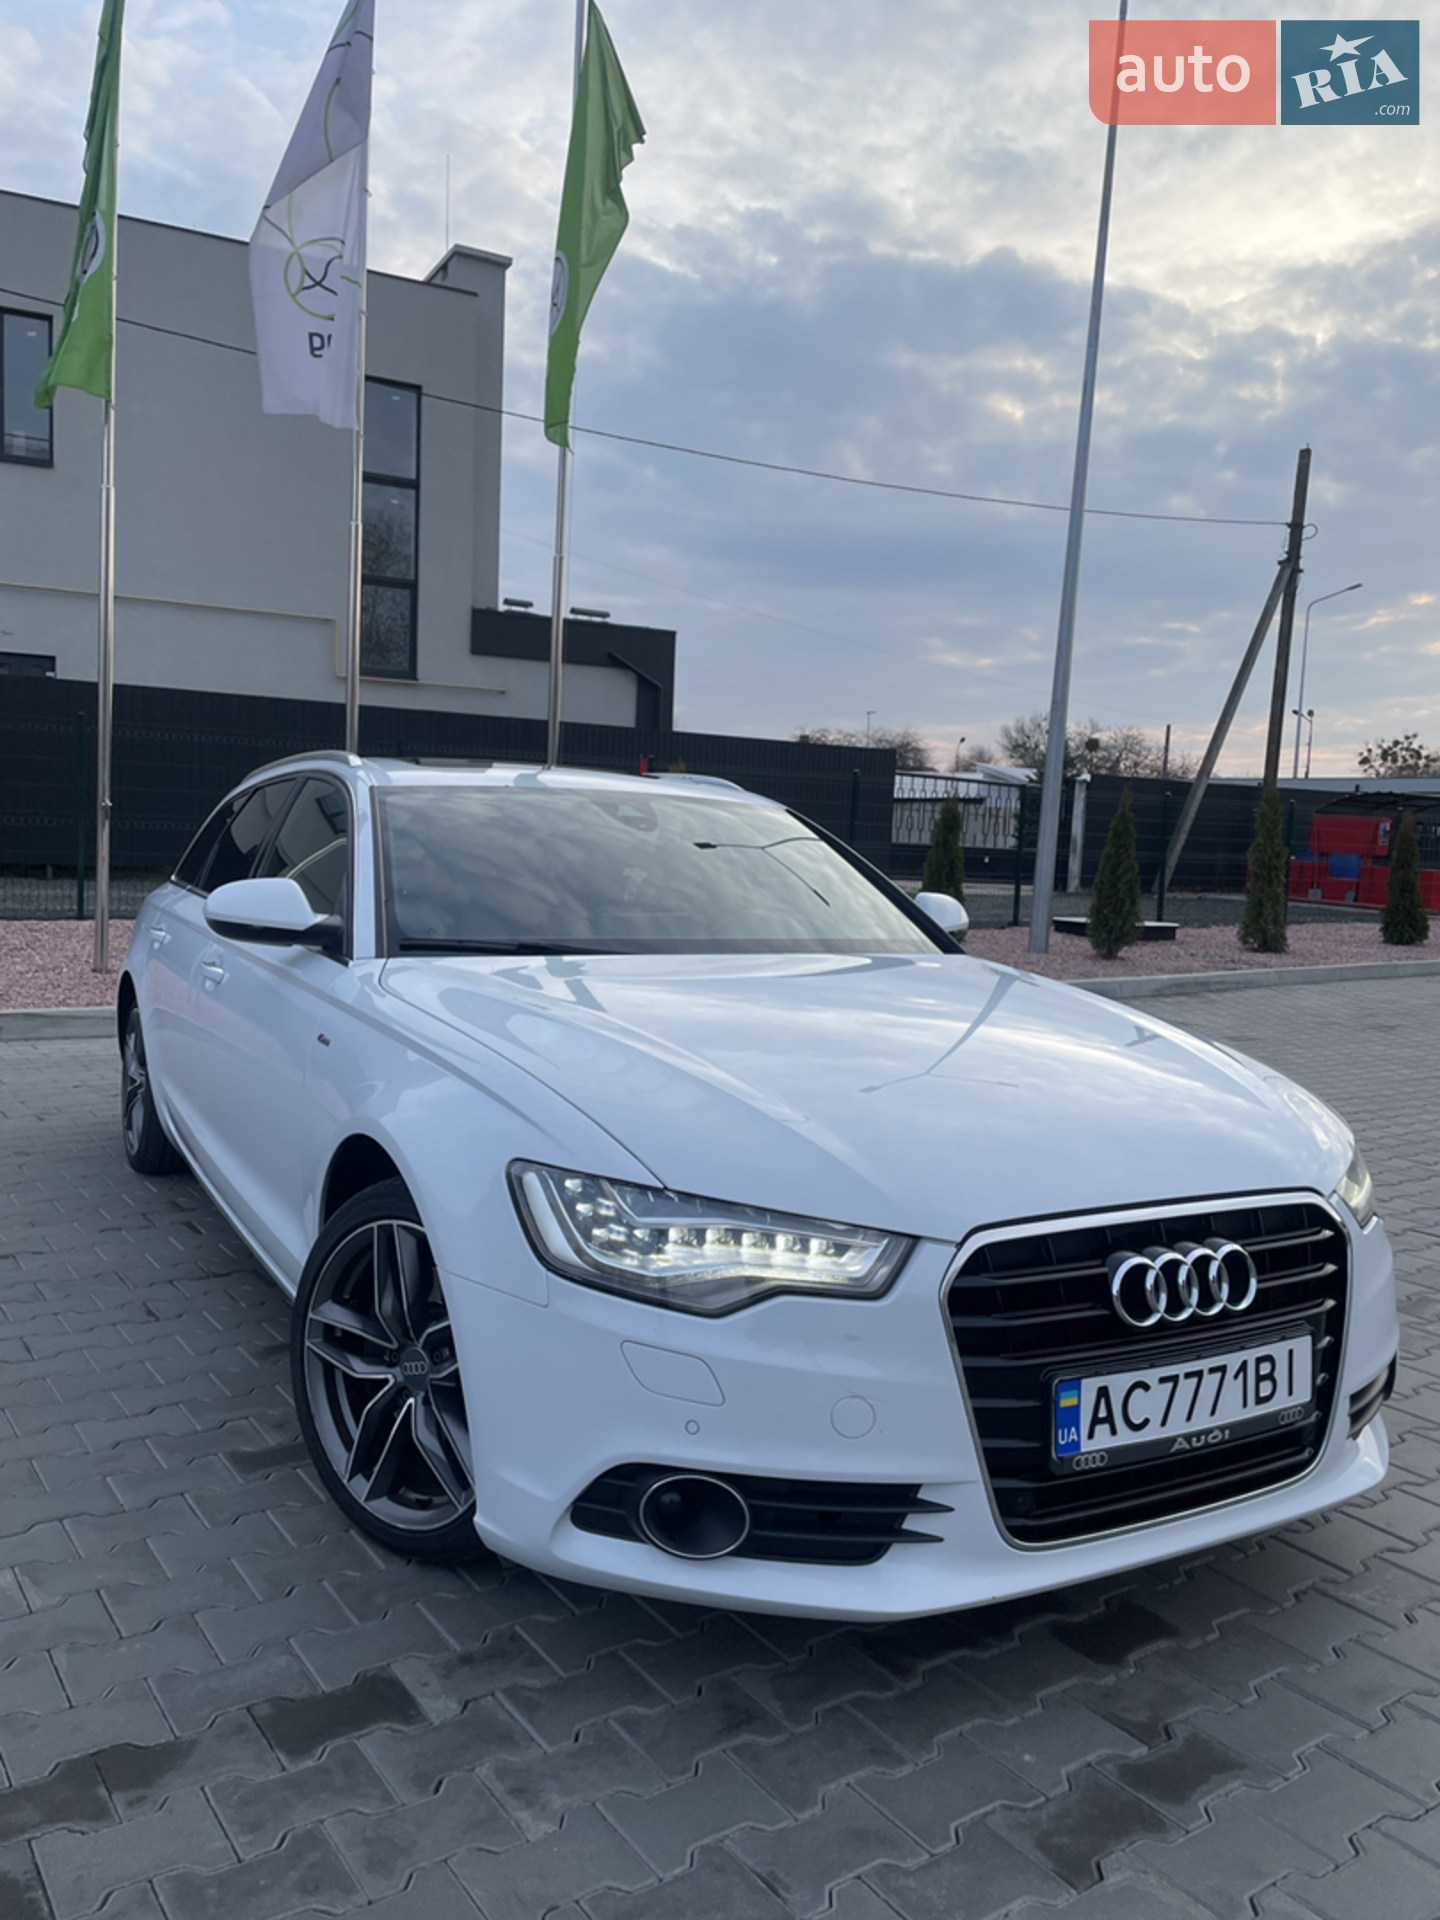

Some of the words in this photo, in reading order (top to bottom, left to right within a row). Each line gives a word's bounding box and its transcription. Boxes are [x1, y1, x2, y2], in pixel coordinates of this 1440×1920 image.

[1058, 1426, 1079, 1445] UA
[1086, 1347, 1295, 1441] AC7771BI
[1170, 1428, 1231, 1453] Audi
